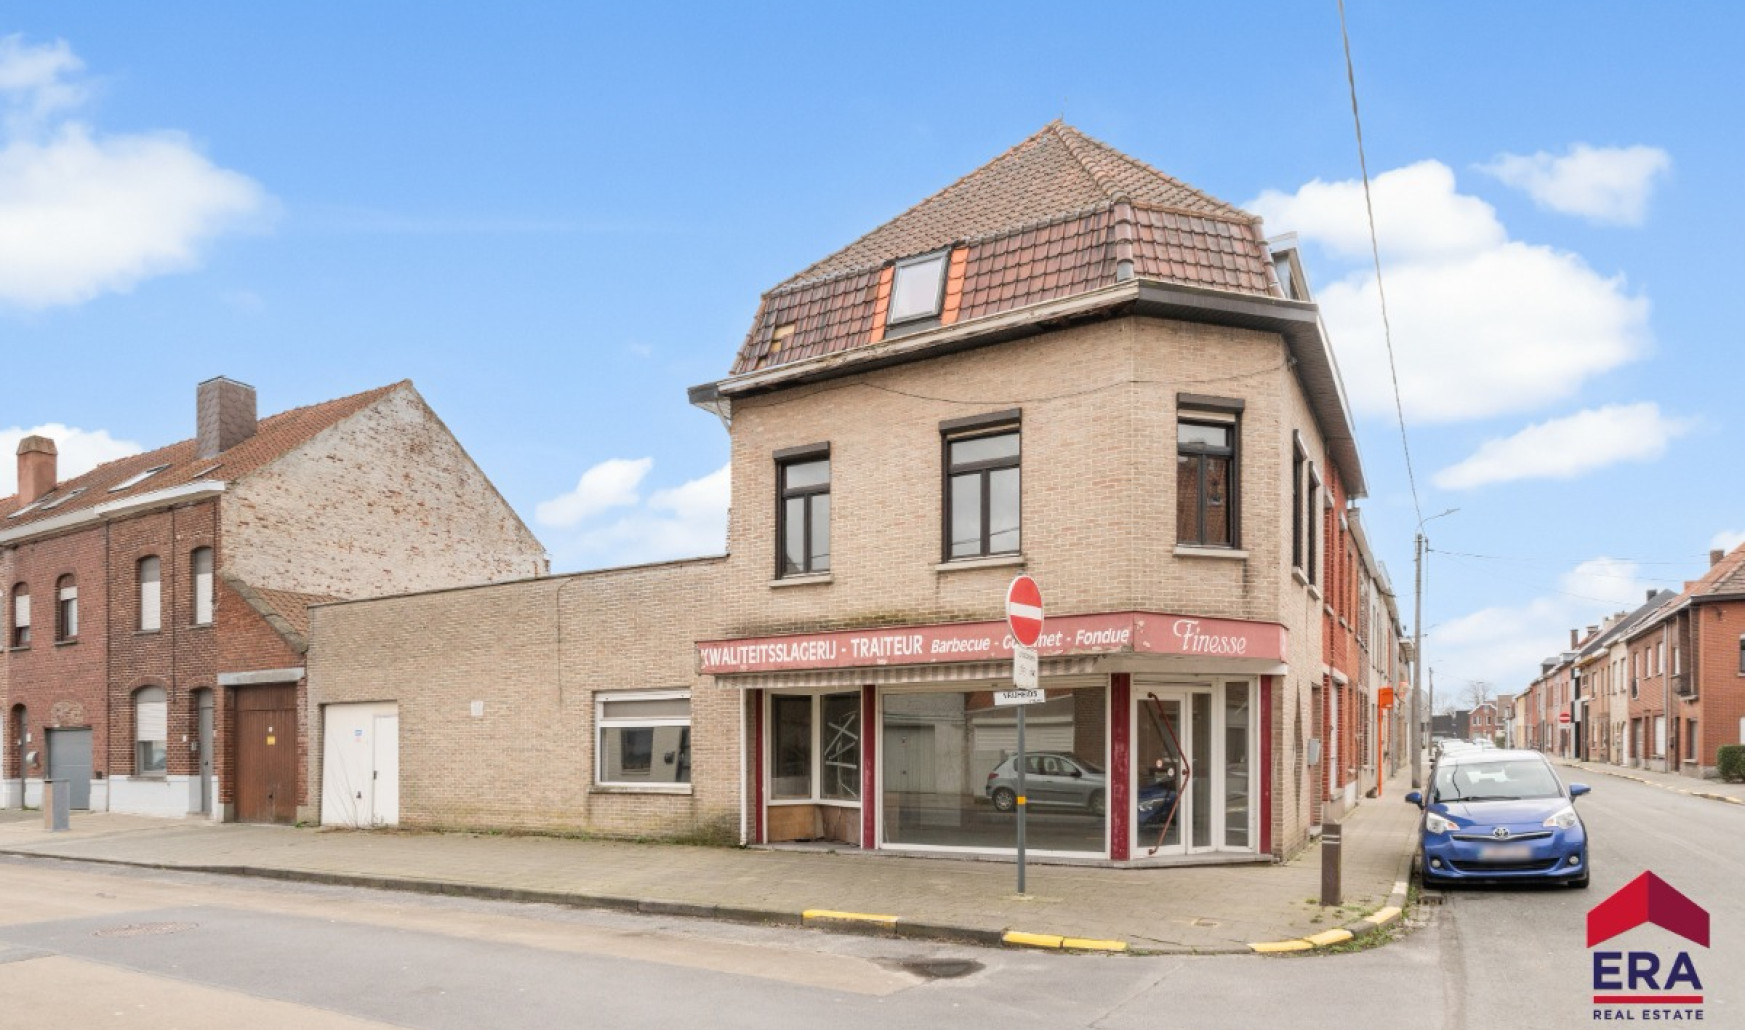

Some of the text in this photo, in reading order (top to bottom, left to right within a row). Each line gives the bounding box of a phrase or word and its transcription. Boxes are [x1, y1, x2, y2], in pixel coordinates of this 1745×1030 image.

[701, 640, 836, 667] KWALITEITSSLAGERIJ
[850, 635, 923, 657] TRAITEUR
[930, 637, 991, 654] Barbecue
[1002, 630, 1063, 649] Gomet
[1075, 627, 1129, 645] Fondue
[1172, 618, 1247, 654] Finesse
